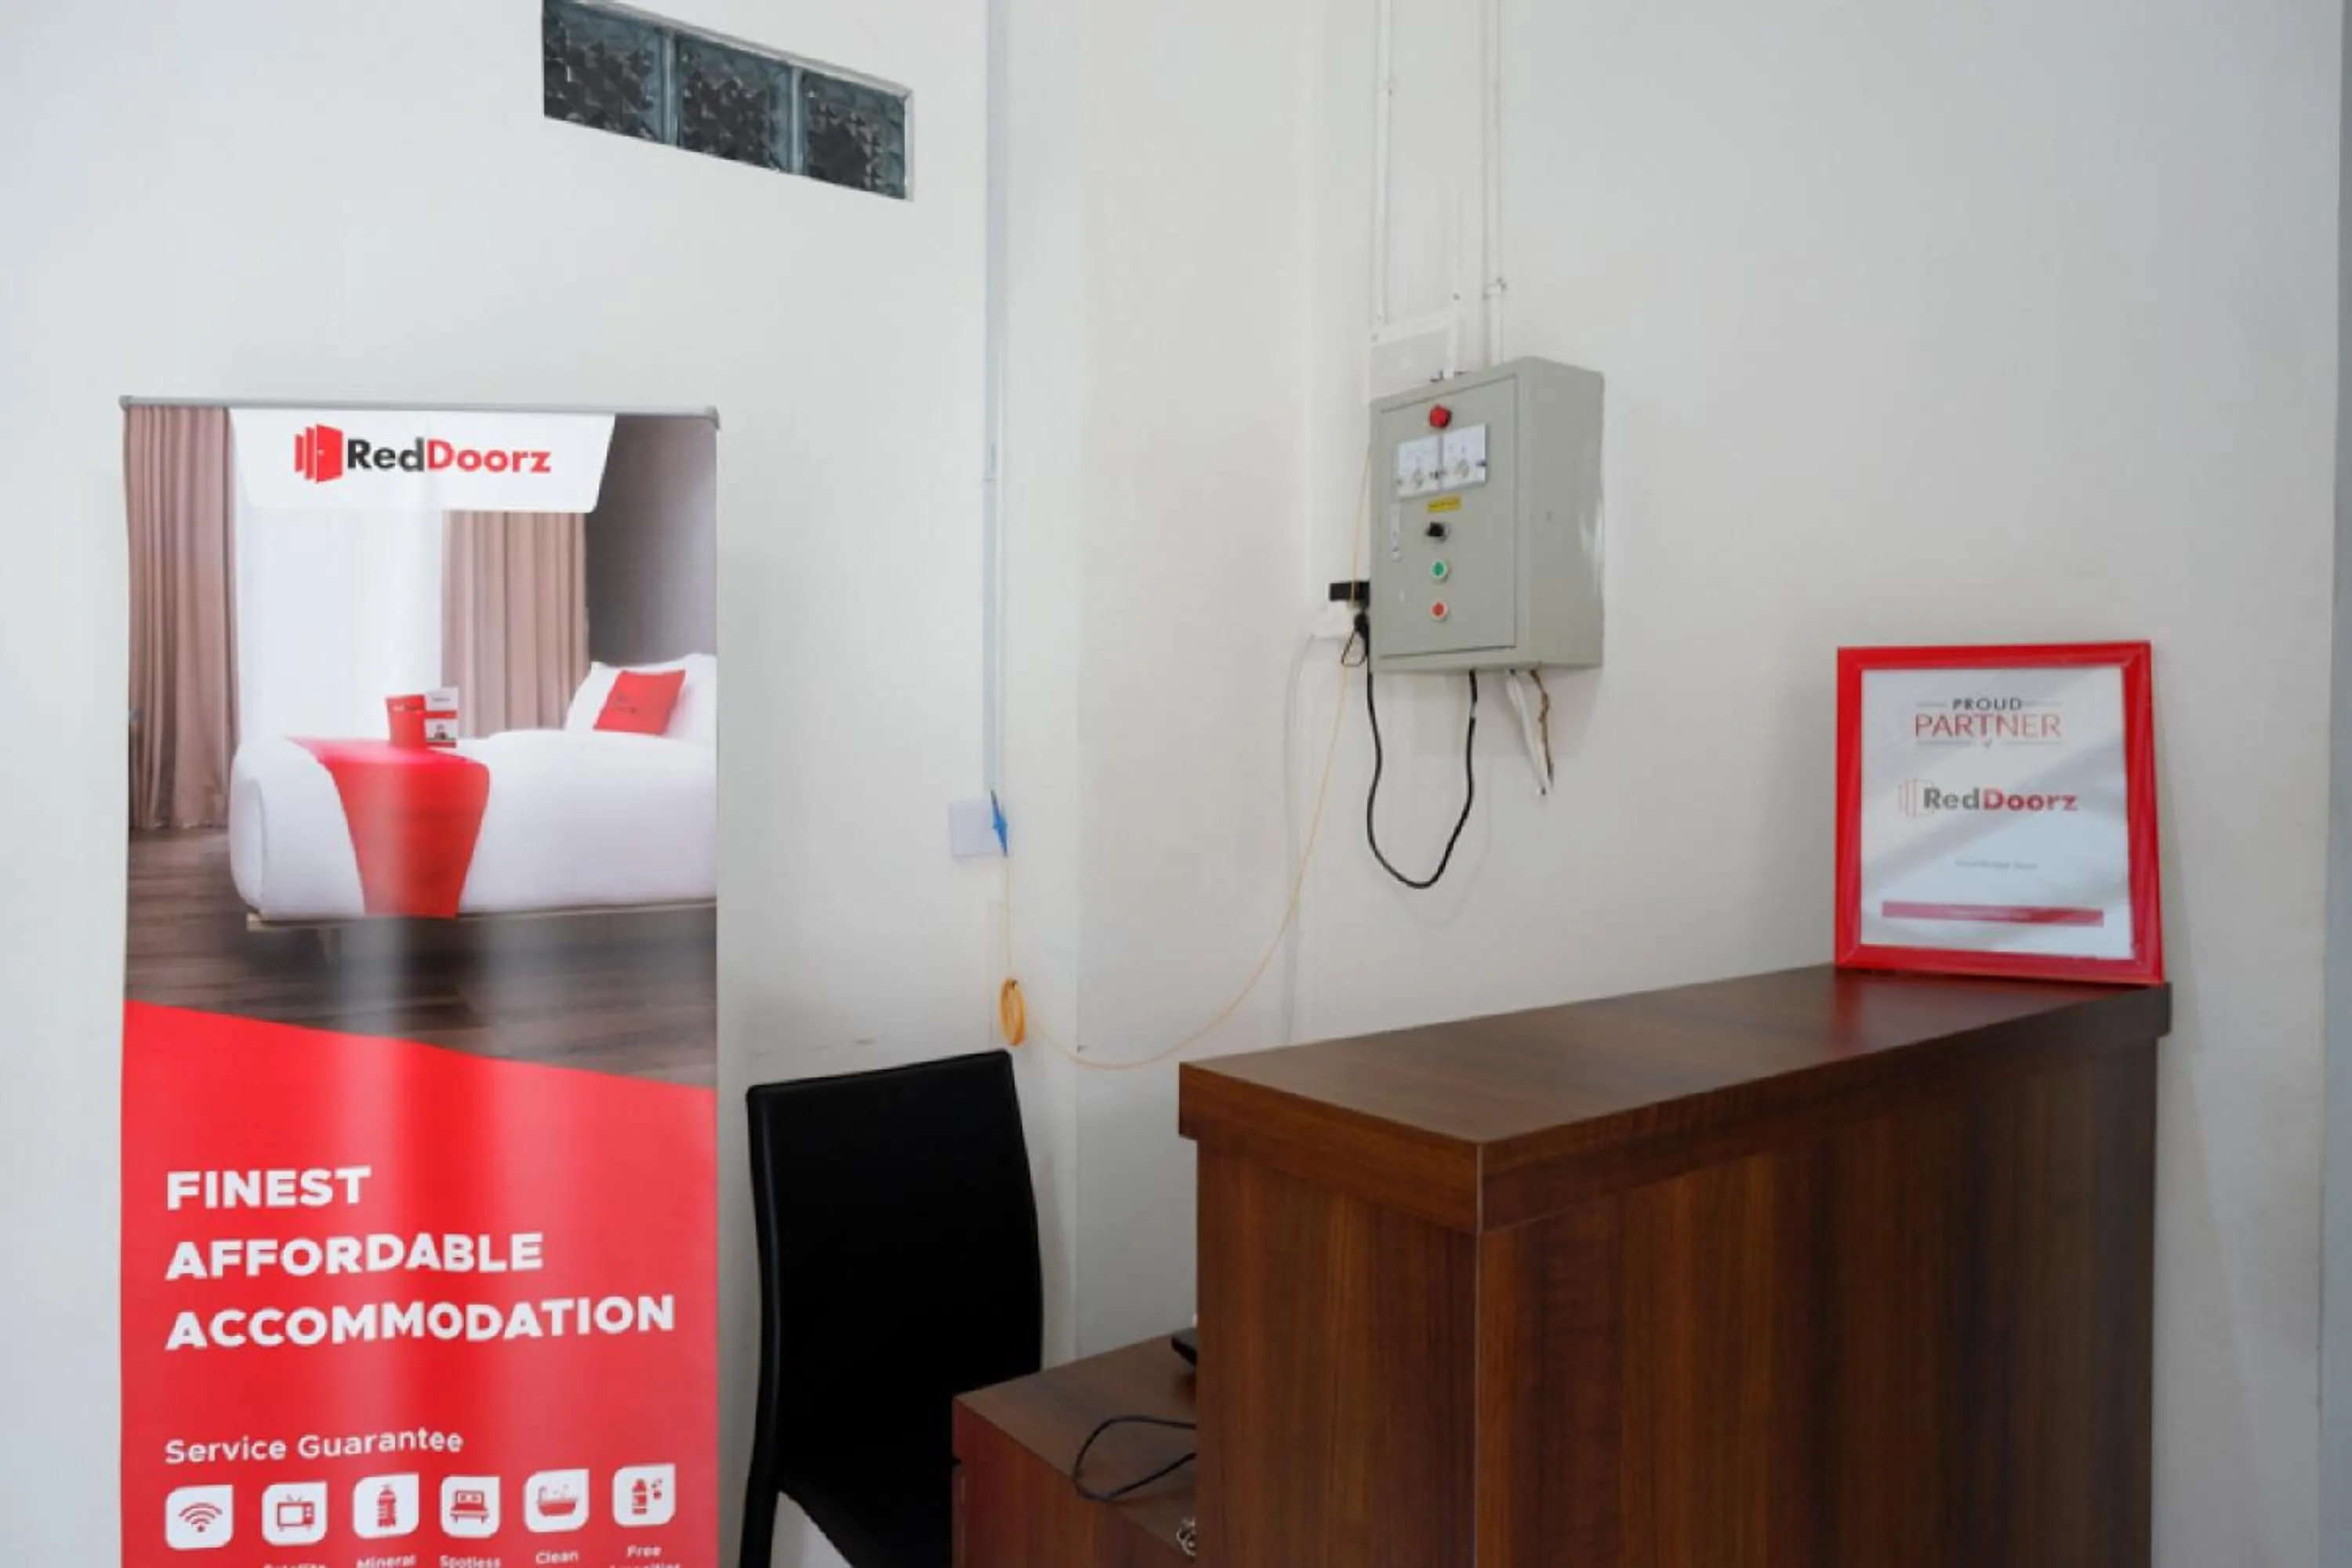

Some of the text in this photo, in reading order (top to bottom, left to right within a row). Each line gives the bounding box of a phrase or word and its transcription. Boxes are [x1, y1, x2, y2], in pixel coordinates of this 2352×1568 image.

[347, 437, 551, 473] RedDoorz
[1952, 697, 2023, 711] PROUD
[1915, 713, 2061, 738] PARTNER
[1923, 787, 2078, 811] RedDoorz
[167, 1165, 372, 1210] FINEST
[165, 1232, 543, 1279] AFFORDABLE
[165, 1294, 674, 1350] ACCOMMODATION
[165, 1428, 463, 1464] Service Guarantee
[356, 1555, 416, 1568] Mineral
[440, 1555, 502, 1568] Spotless
[535, 1550, 579, 1564] Clean
[627, 1544, 662, 1557] Free
